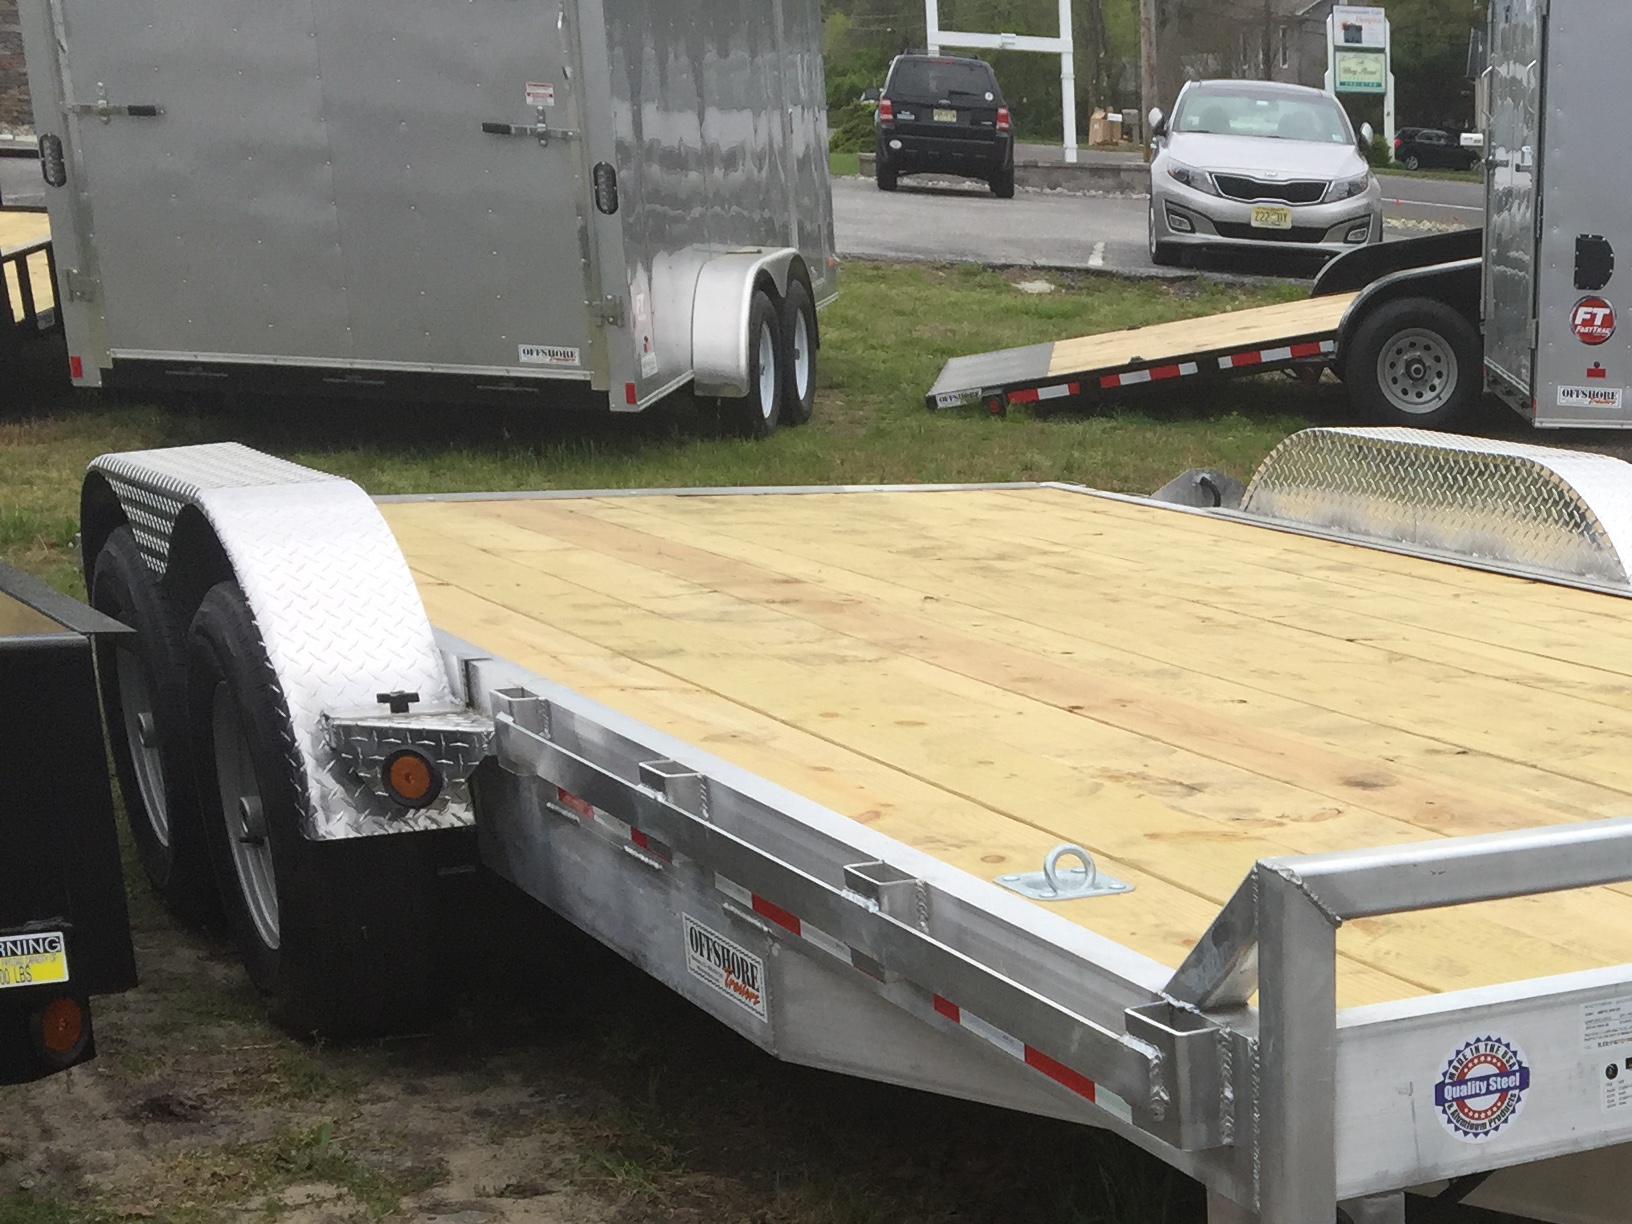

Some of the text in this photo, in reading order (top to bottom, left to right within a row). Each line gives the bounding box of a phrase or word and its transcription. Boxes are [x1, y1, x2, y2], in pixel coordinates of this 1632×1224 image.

[1574, 306, 1611, 326] FT
[1561, 388, 1618, 400] OFFSHORE
[689, 926, 760, 993] OFFSHORE
[1447, 1043, 1517, 1081] MADE IN THE USA
[1444, 1072, 1520, 1100] Quality Steel
[1488, 1093, 1517, 1128] Products
